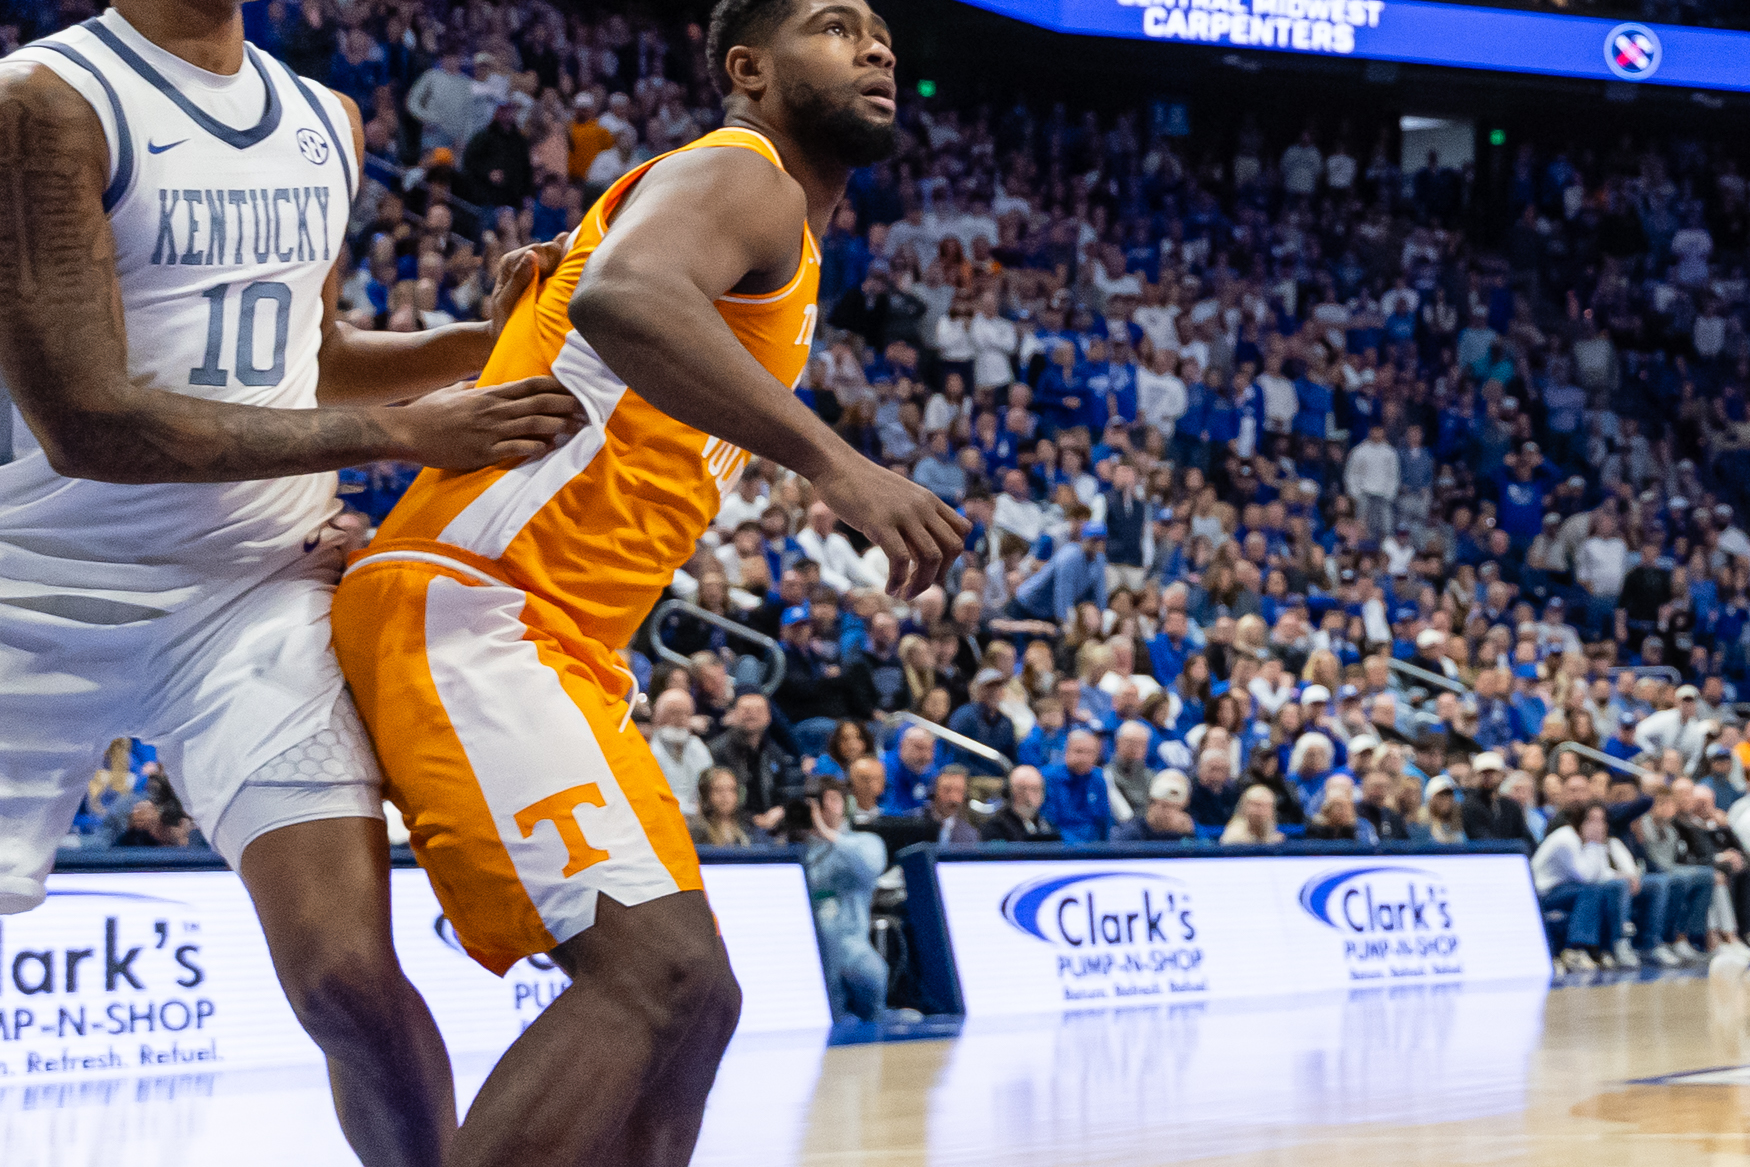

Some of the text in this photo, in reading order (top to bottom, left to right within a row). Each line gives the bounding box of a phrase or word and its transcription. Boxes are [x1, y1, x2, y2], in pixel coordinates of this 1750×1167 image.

[1142, 6, 1356, 54] CARPENTERS
[150, 186, 330, 266] KENTUCKY
[188, 281, 292, 387] 10
[513, 781, 610, 879] T
[1058, 890, 1195, 946] Clark's
[1344, 881, 1453, 932] Clark's
[1057, 948, 1203, 978] PUMP-N-SHOP
